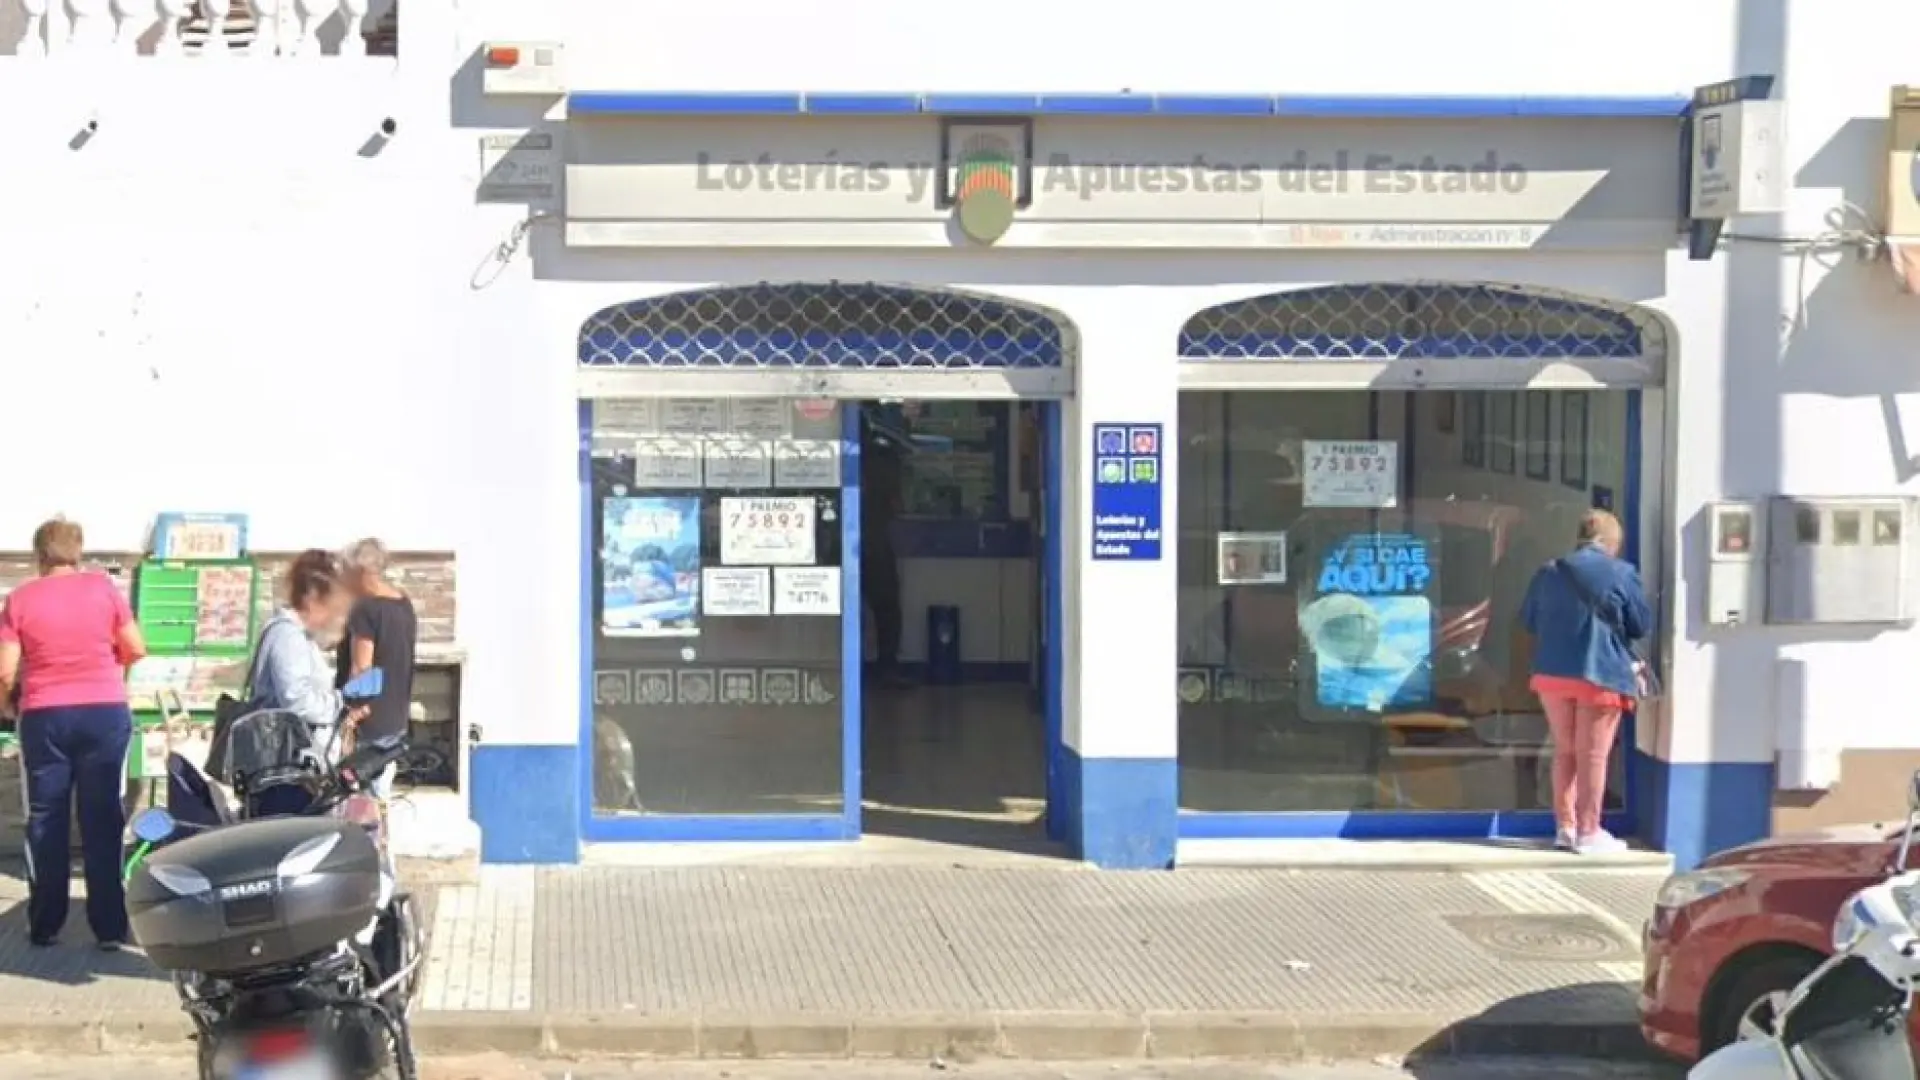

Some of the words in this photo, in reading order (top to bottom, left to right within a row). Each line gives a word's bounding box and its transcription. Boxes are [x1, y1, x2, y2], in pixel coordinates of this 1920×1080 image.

[697, 150, 890, 192] Loterías
[905, 159, 932, 204] y
[1042, 153, 1264, 201] Apuestas
[1278, 149, 1348, 193] del
[1363, 149, 1527, 194] Estado
[1332, 443, 1379, 455] PREMIO
[750, 501, 798, 512] PREMIO
[1143, 528, 1160, 539] del
[1096, 543, 1131, 555] Estado
[1352, 547, 1374, 563] SI
[1377, 547, 1426, 563] CAE
[221, 880, 271, 899] SHAD
